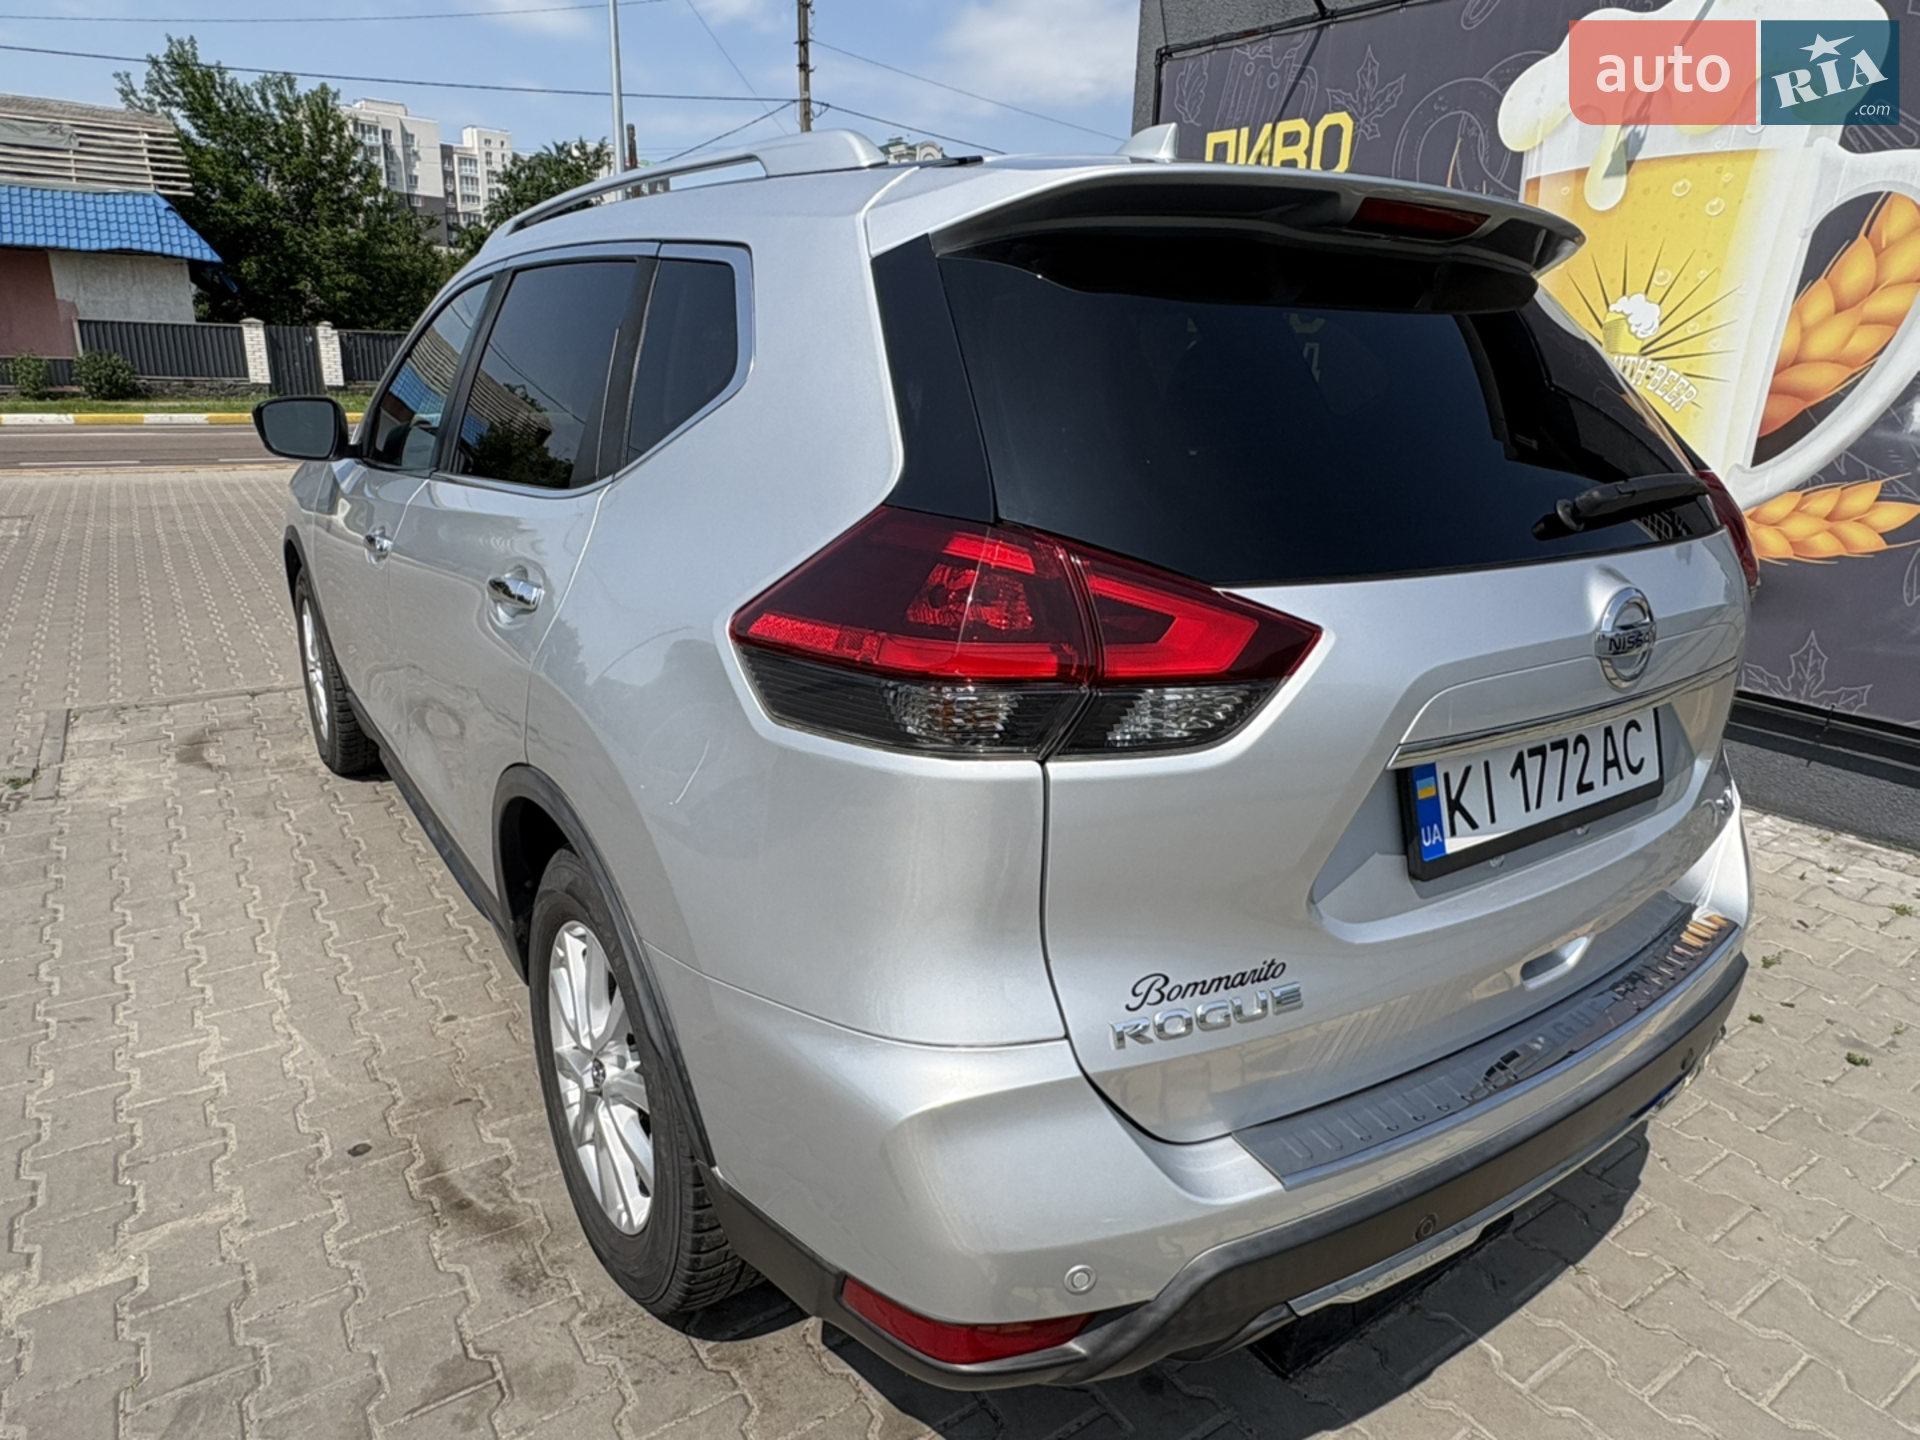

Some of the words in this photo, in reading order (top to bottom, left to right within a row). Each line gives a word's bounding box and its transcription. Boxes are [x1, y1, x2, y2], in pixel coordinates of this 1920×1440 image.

[1443, 760, 1497, 838] KI
[1509, 734, 1595, 813] 1772
[1602, 719, 1645, 787] AC
[1421, 823, 1443, 847] UA
[1109, 981, 1304, 1051] ROGUE
[1124, 958, 1287, 1012] Bommarito
